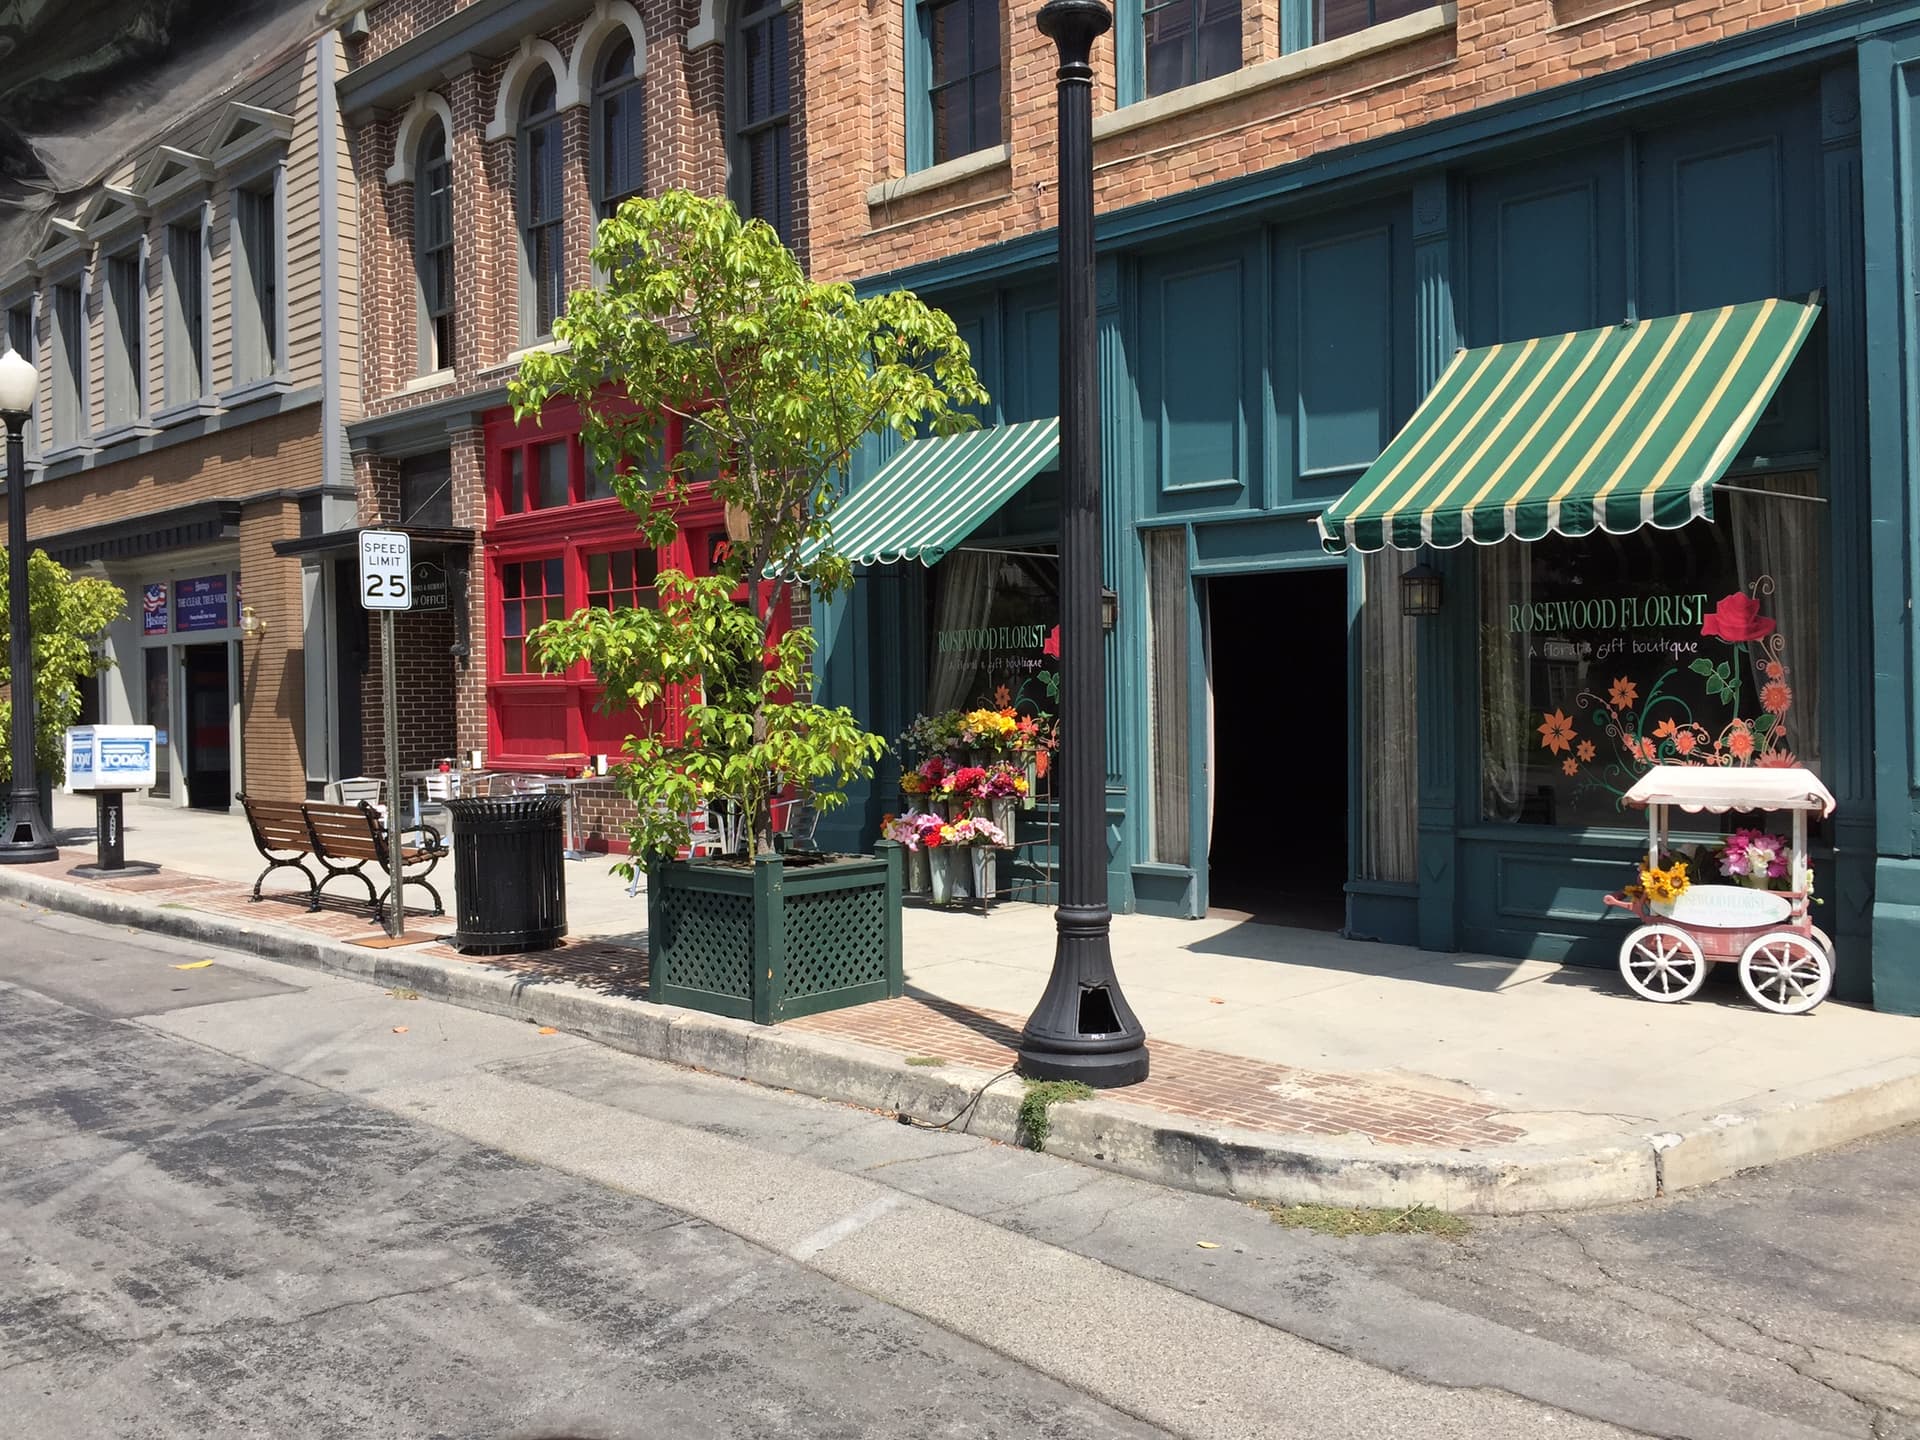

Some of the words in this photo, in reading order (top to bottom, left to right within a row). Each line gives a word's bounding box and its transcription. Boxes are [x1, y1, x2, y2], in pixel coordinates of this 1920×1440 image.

[364, 542, 406, 554] SPEED
[368, 555, 401, 567] LIMIT
[366, 573, 406, 598] 25
[420, 594, 445, 607] OFFICE
[1509, 598, 1616, 633] ROSEWOOD
[1620, 593, 1708, 628] FLORIST
[938, 627, 998, 653] ROSEWOOD
[999, 624, 1046, 649] FLORIST
[1596, 637, 1626, 659] gift
[1633, 637, 1698, 661] boutique
[103, 753, 147, 767] TODAY
